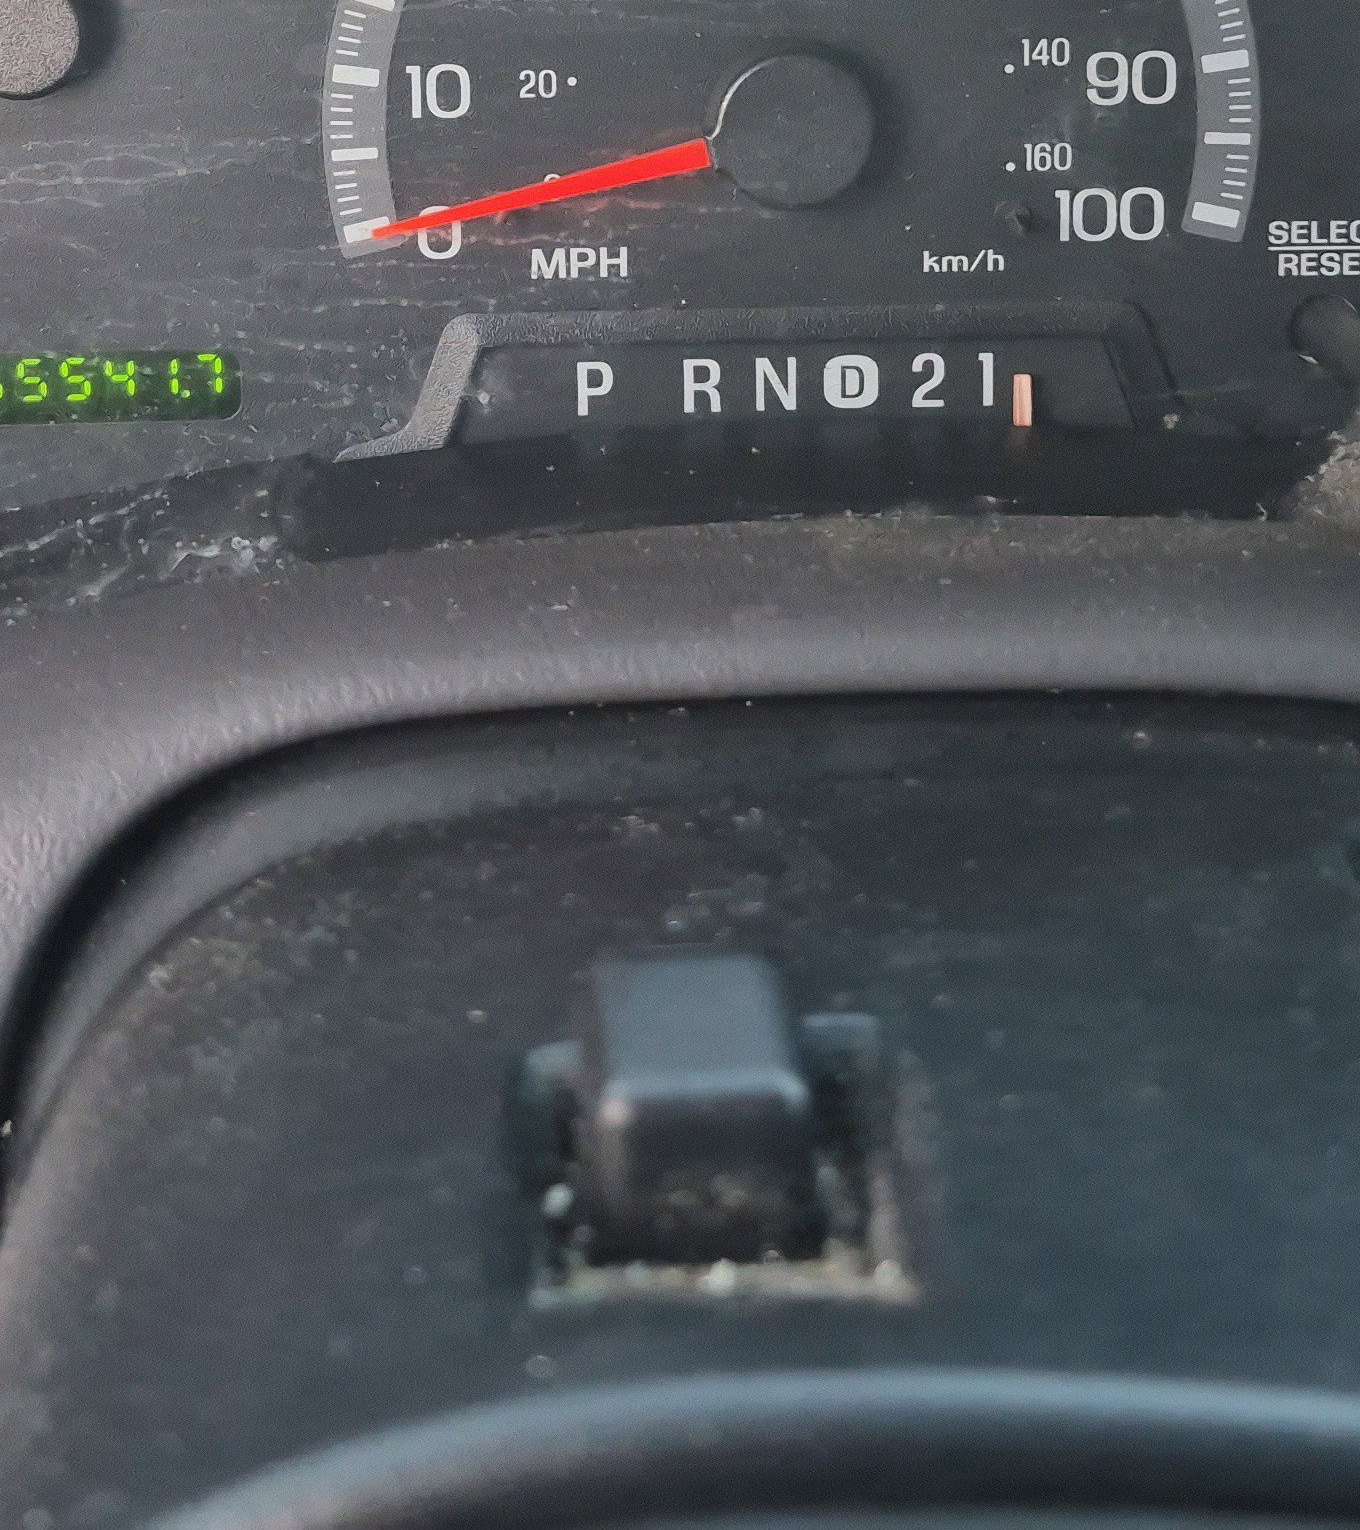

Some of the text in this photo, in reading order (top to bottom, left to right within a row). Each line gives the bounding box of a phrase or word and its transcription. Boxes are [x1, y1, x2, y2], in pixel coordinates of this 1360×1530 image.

[1021, 37, 1071, 67] 140
[405, 63, 471, 119] 10
[518, 70, 558, 99] 20
[1086, 50, 1177, 106] 90
[1023, 142, 1073, 172] 160
[417, 205, 463, 260] 0
[1054, 186, 1165, 242] 100
[530, 246, 629, 280] MPH
[922, 248, 1005, 273] km/h
[576, 361, 614, 416] P
[682, 358, 722, 413] R
[755, 356, 798, 411] N
[911, 352, 946, 408] 2
[977, 351, 995, 407] 1
